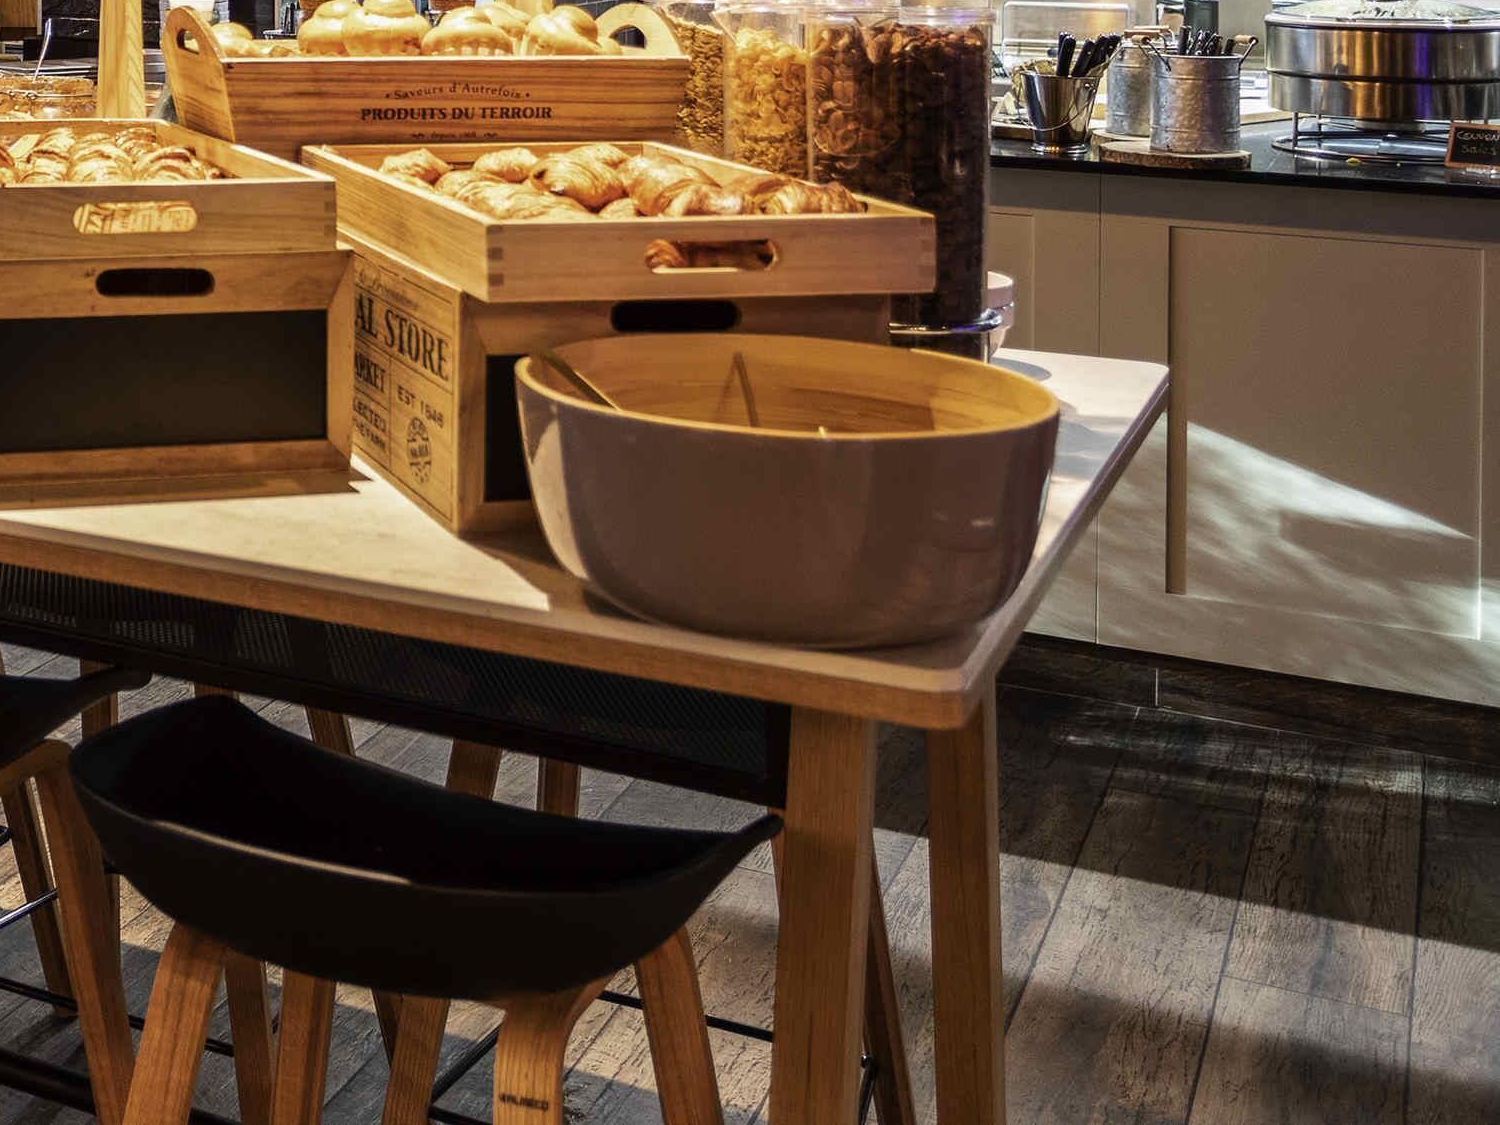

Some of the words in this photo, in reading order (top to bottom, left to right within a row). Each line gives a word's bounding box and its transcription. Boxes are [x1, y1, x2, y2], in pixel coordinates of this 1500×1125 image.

[394, 86, 444, 100] Saveurs
[360, 107, 448, 121] PRODUITS
[452, 107, 475, 120] DU
[480, 106, 553, 120] TERROIR
[384, 308, 449, 381] STORE
[355, 352, 385, 393] ARKET
[397, 385, 416, 405] EST
[353, 396, 387, 433] LECTED
